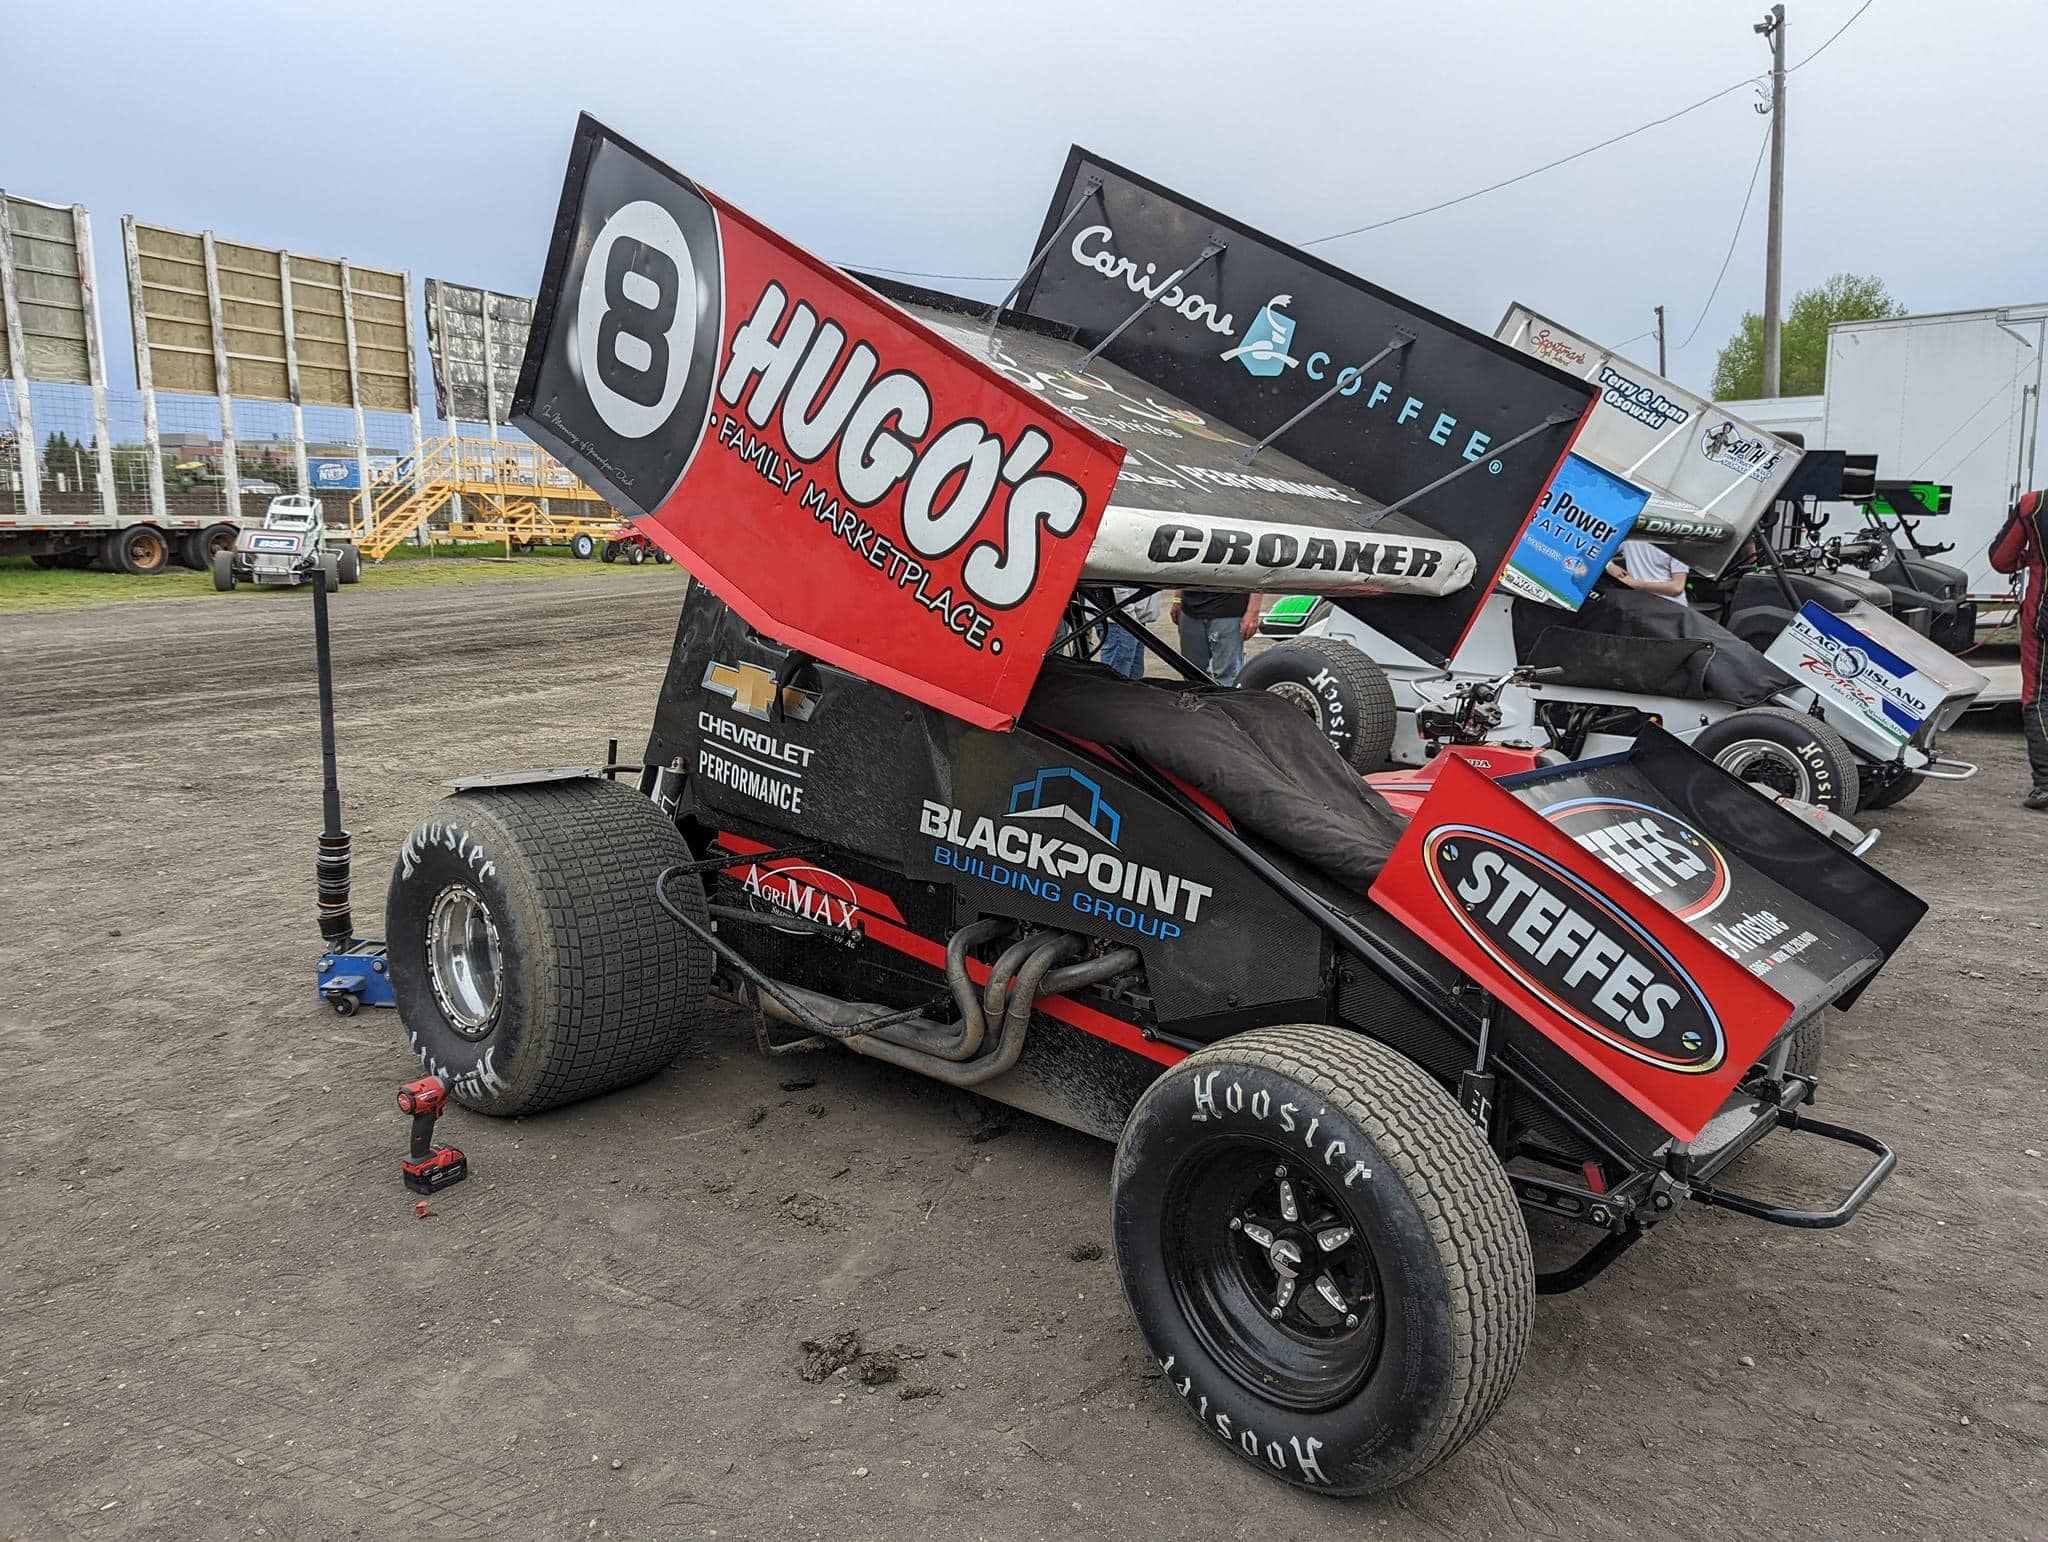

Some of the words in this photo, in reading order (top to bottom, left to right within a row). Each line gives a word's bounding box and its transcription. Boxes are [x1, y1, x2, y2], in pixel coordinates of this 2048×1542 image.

[1071, 225, 1235, 336] Caribou
[596, 235, 681, 408] 8
[551, 413, 580, 443] Memory
[1306, 351, 1491, 462] COFFEE
[1600, 367, 1639, 397] Terry
[1637, 389, 1652, 404] &
[1651, 396, 1688, 423] Joan
[1604, 390, 1667, 428] Osowski
[719, 280, 1086, 607] HUGO'S
[719, 419, 803, 496] FAMILY
[800, 481, 990, 648] MARKETPLACE
[1146, 523, 1444, 579] CROAKER
[1530, 511, 1601, 559] RATIVE
[1551, 491, 1618, 543] Power
[1307, 667, 1352, 750] Hoosi
[1865, 668, 1927, 711] ISLAND
[698, 711, 815, 768] CHEVROLET
[1797, 741, 1837, 811] Hoosi
[698, 751, 805, 815] PERFORMANCE
[919, 799, 1213, 924] BLACKPOINT
[934, 846, 1061, 902] BUILDING
[1072, 891, 1181, 941] GROUP
[1574, 817, 1707, 897] EFFES
[1458, 851, 1681, 1039] STEFFES
[1711, 910, 1790, 953] Krostue
[1191, 1070, 1373, 1188] Hoosier
[1158, 1355, 1330, 1485] Hoosier
